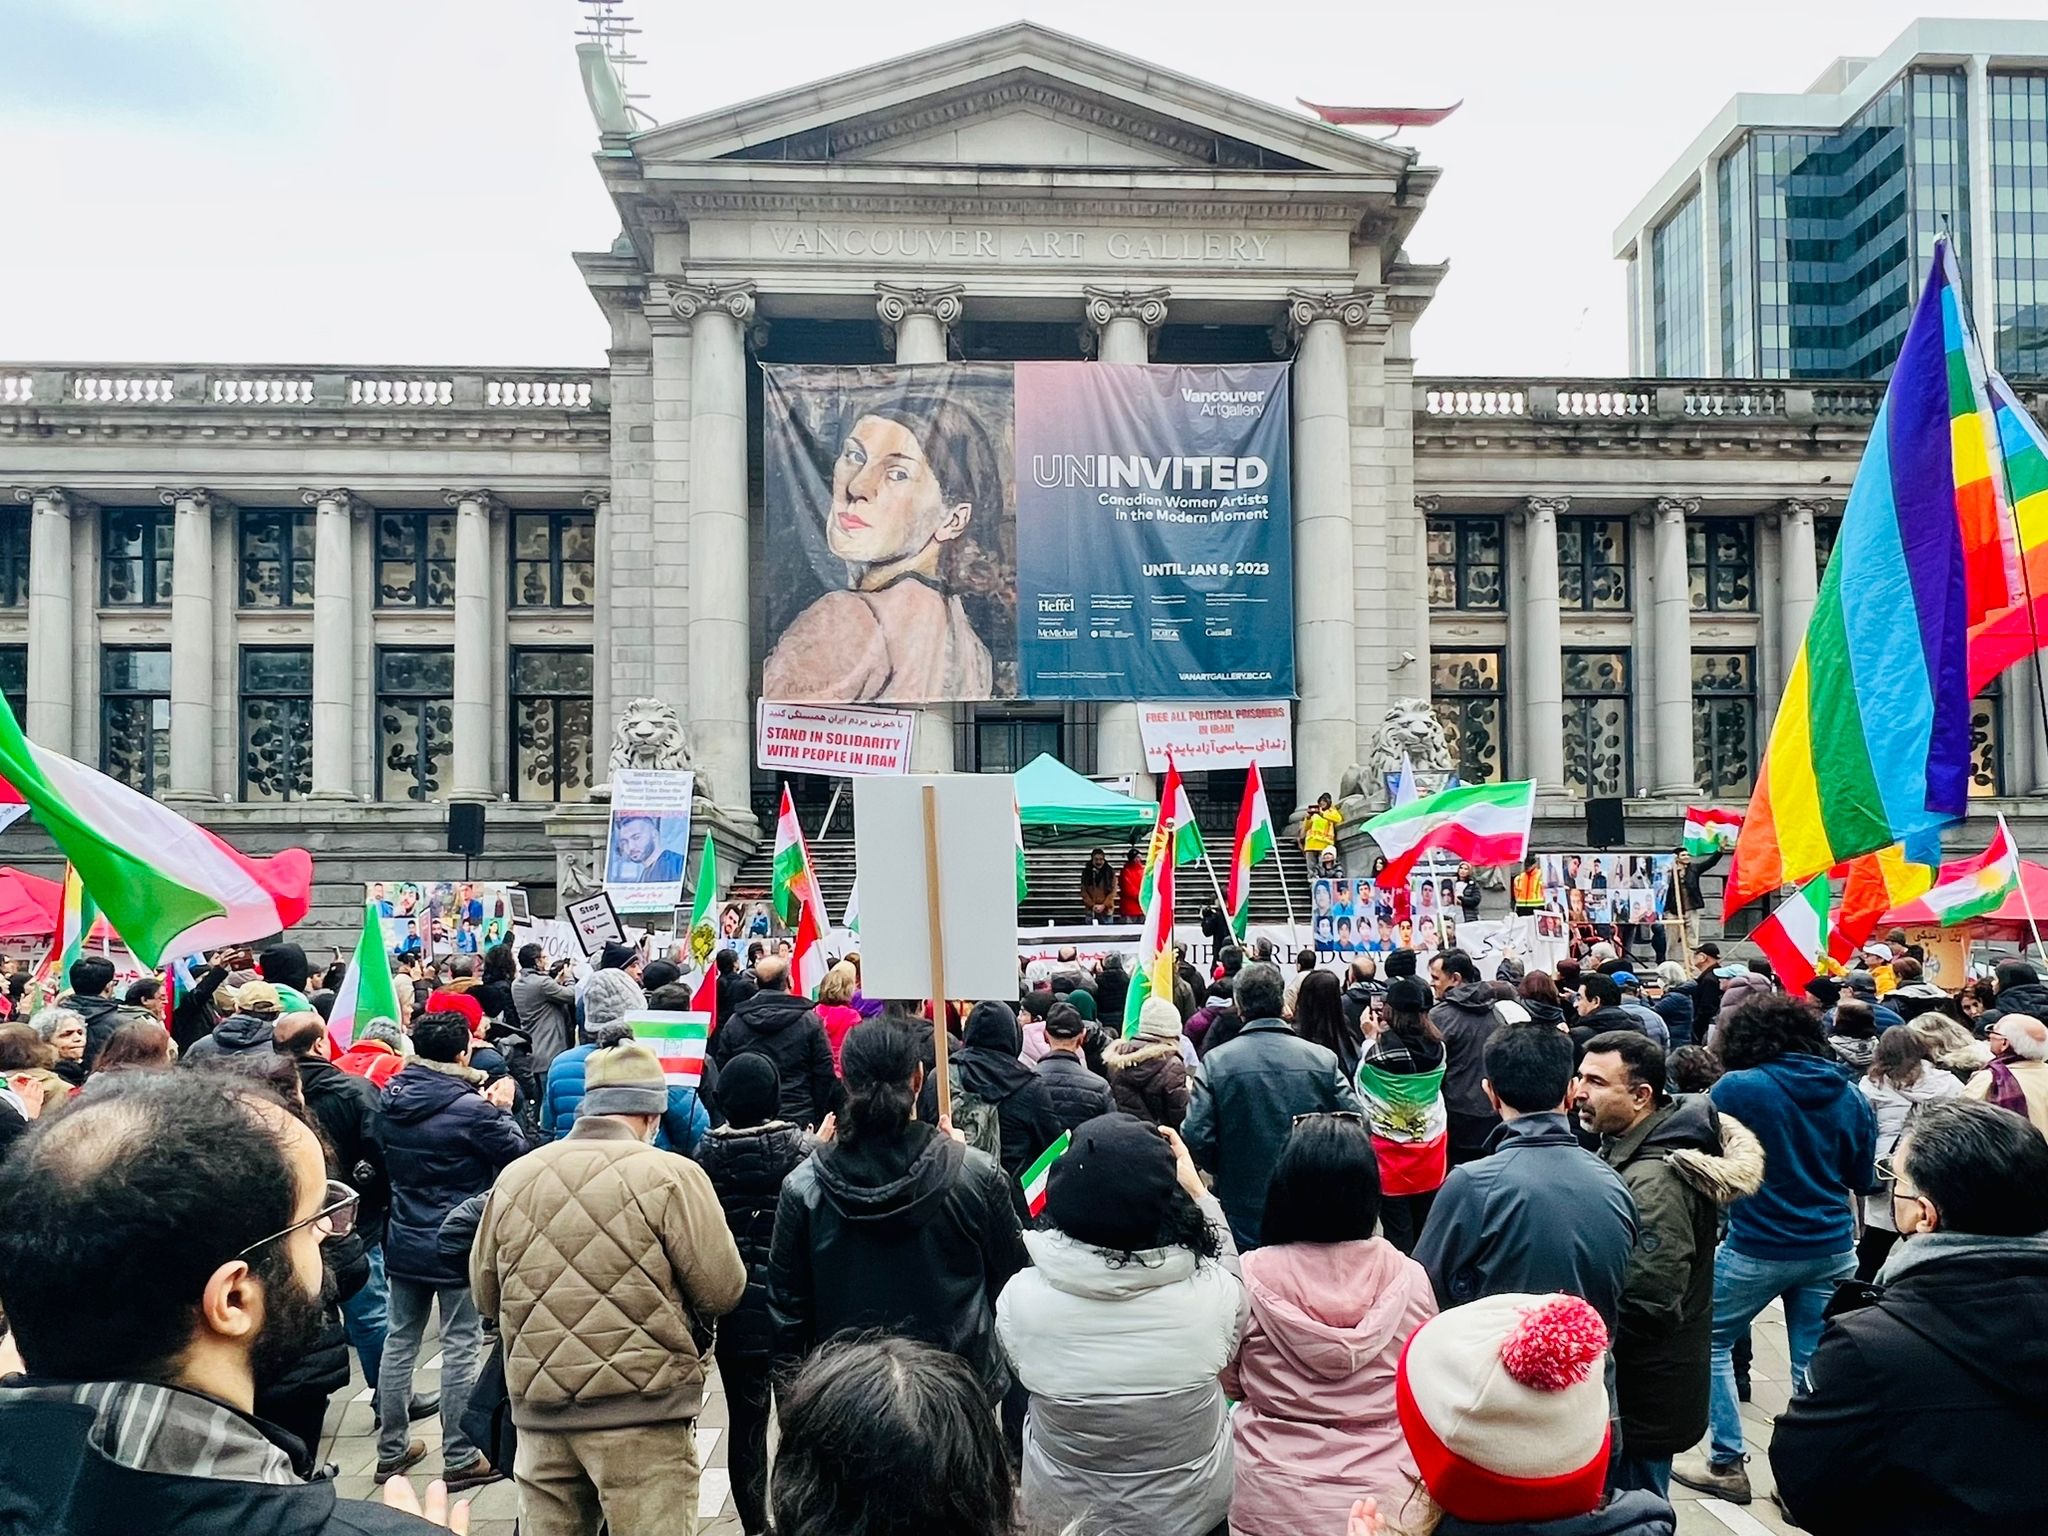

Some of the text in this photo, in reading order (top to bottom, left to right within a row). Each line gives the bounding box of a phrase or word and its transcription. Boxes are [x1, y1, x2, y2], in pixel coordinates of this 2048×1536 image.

[767, 225, 1272, 262] VANCOUVER ART GALLERY
[1181, 387, 1265, 403] Vancouver
[1033, 454, 1269, 491] UNINVITED
[1097, 493, 1269, 508] Canadian Women Artists
[1115, 508, 1269, 523] in the Modern Moment
[1142, 562, 1270, 577] UNTIL JAN 8, 2023
[1038, 599, 1075, 612] Heffel
[1146, 706, 1285, 722] FREE ALL POLITICAL PRISONERS
[767, 727, 900, 750] STAND IN SOLIDARITY
[767, 744, 897, 768] WITH PEOPLE IN IRAN
[579, 903, 600, 915] Stop
